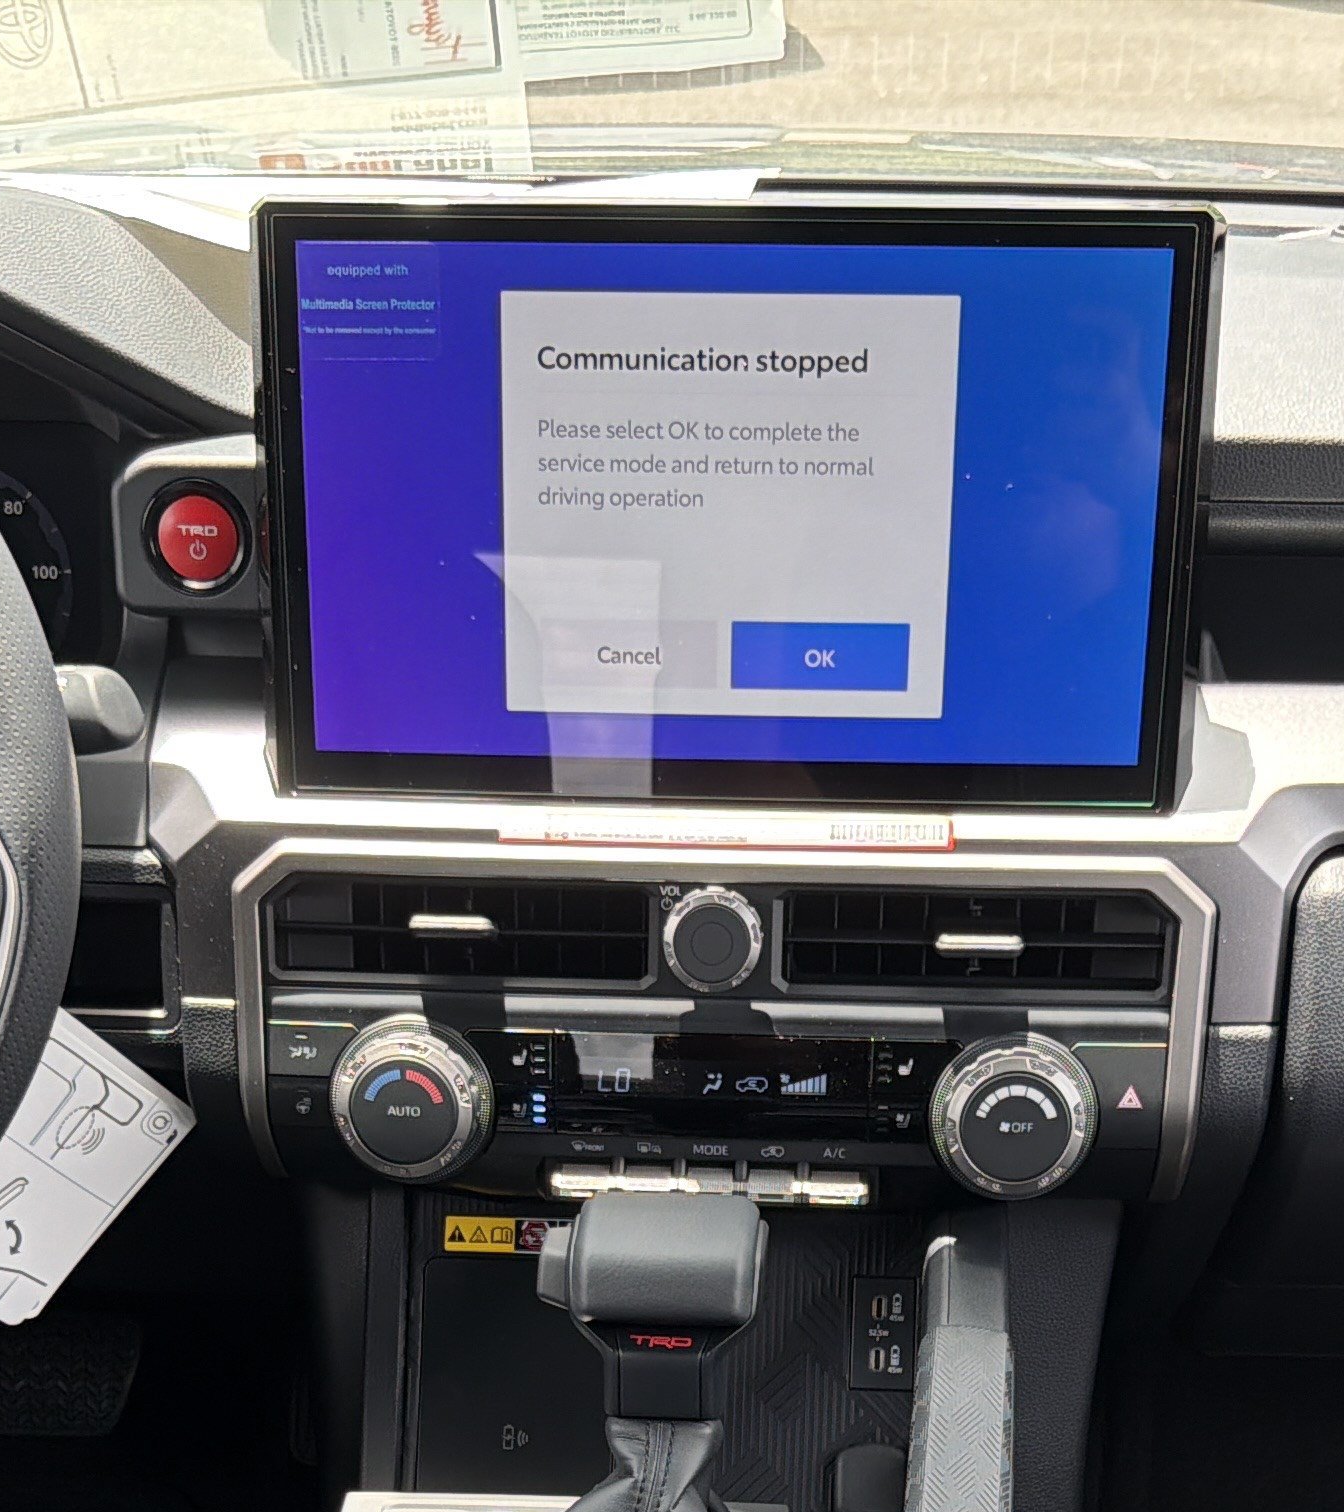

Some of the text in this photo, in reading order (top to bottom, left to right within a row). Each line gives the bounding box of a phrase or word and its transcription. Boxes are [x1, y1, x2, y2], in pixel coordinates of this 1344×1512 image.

[327, 264, 409, 278] equipped with
[301, 299, 435, 310] Multimedia Screen Protector
[537, 346, 870, 380] Communication stopped
[537, 419, 860, 447] Please select OK to complete the
[537, 453, 874, 478] service mode and return to normal
[537, 486, 704, 512] driving operation
[3, 501, 23, 517] 80
[177, 525, 218, 537] TRD
[31, 565, 58, 581] 100
[596, 646, 836, 669] Cancel OK
[659, 885, 682, 897] VOL
[597, 1067, 631, 1093] LO
[387, 1106, 421, 1117] AUTO
[1011, 1122, 1034, 1133] OFF
[692, 1144, 729, 1156] MODE
[823, 1146, 846, 1159] A/C
[629, 1333, 693, 1350] TRD
